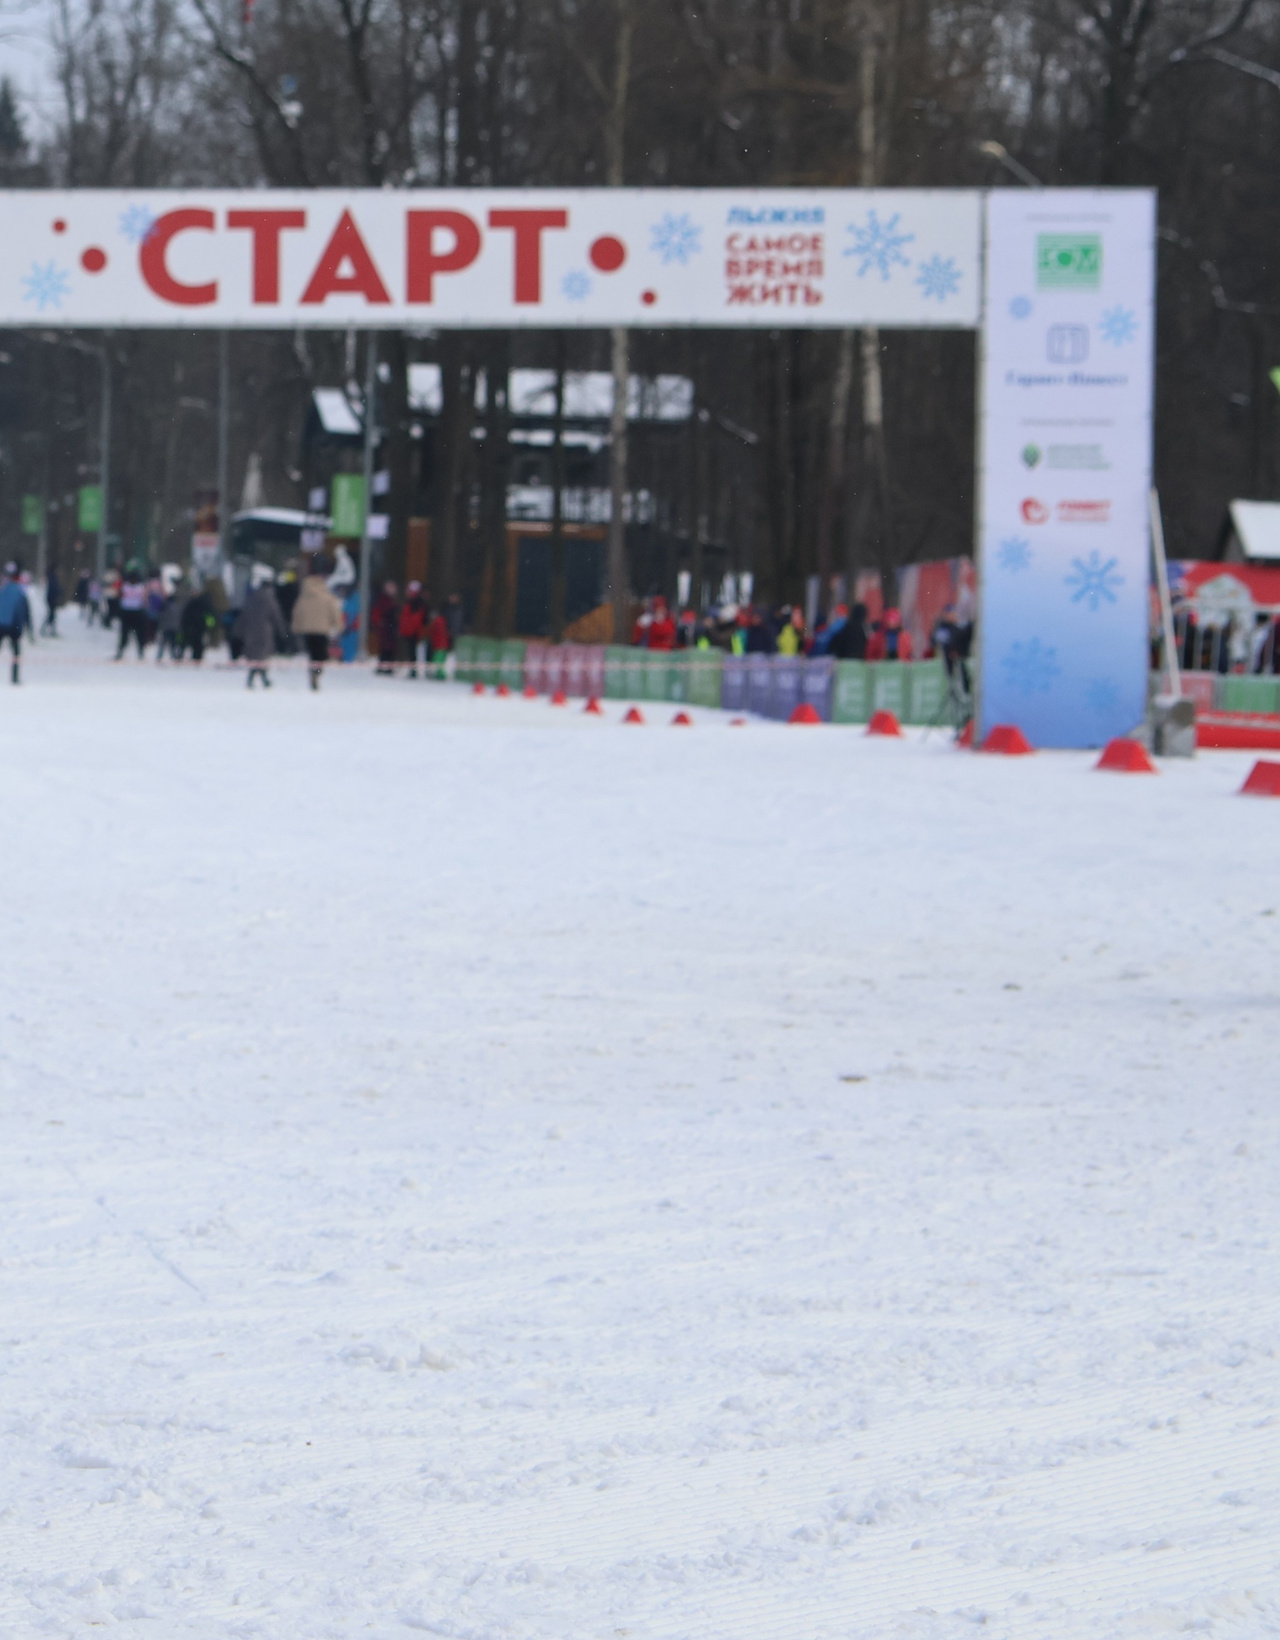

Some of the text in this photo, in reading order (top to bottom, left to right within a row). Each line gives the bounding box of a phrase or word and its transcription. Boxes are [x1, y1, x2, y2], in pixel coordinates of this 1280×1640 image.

[726, 232, 824, 253] САМОЕ
[139, 207, 568, 306] СТАРТ
[726, 259, 824, 278] ВРЕМЯ
[726, 283, 823, 305] ЖИТЬ
